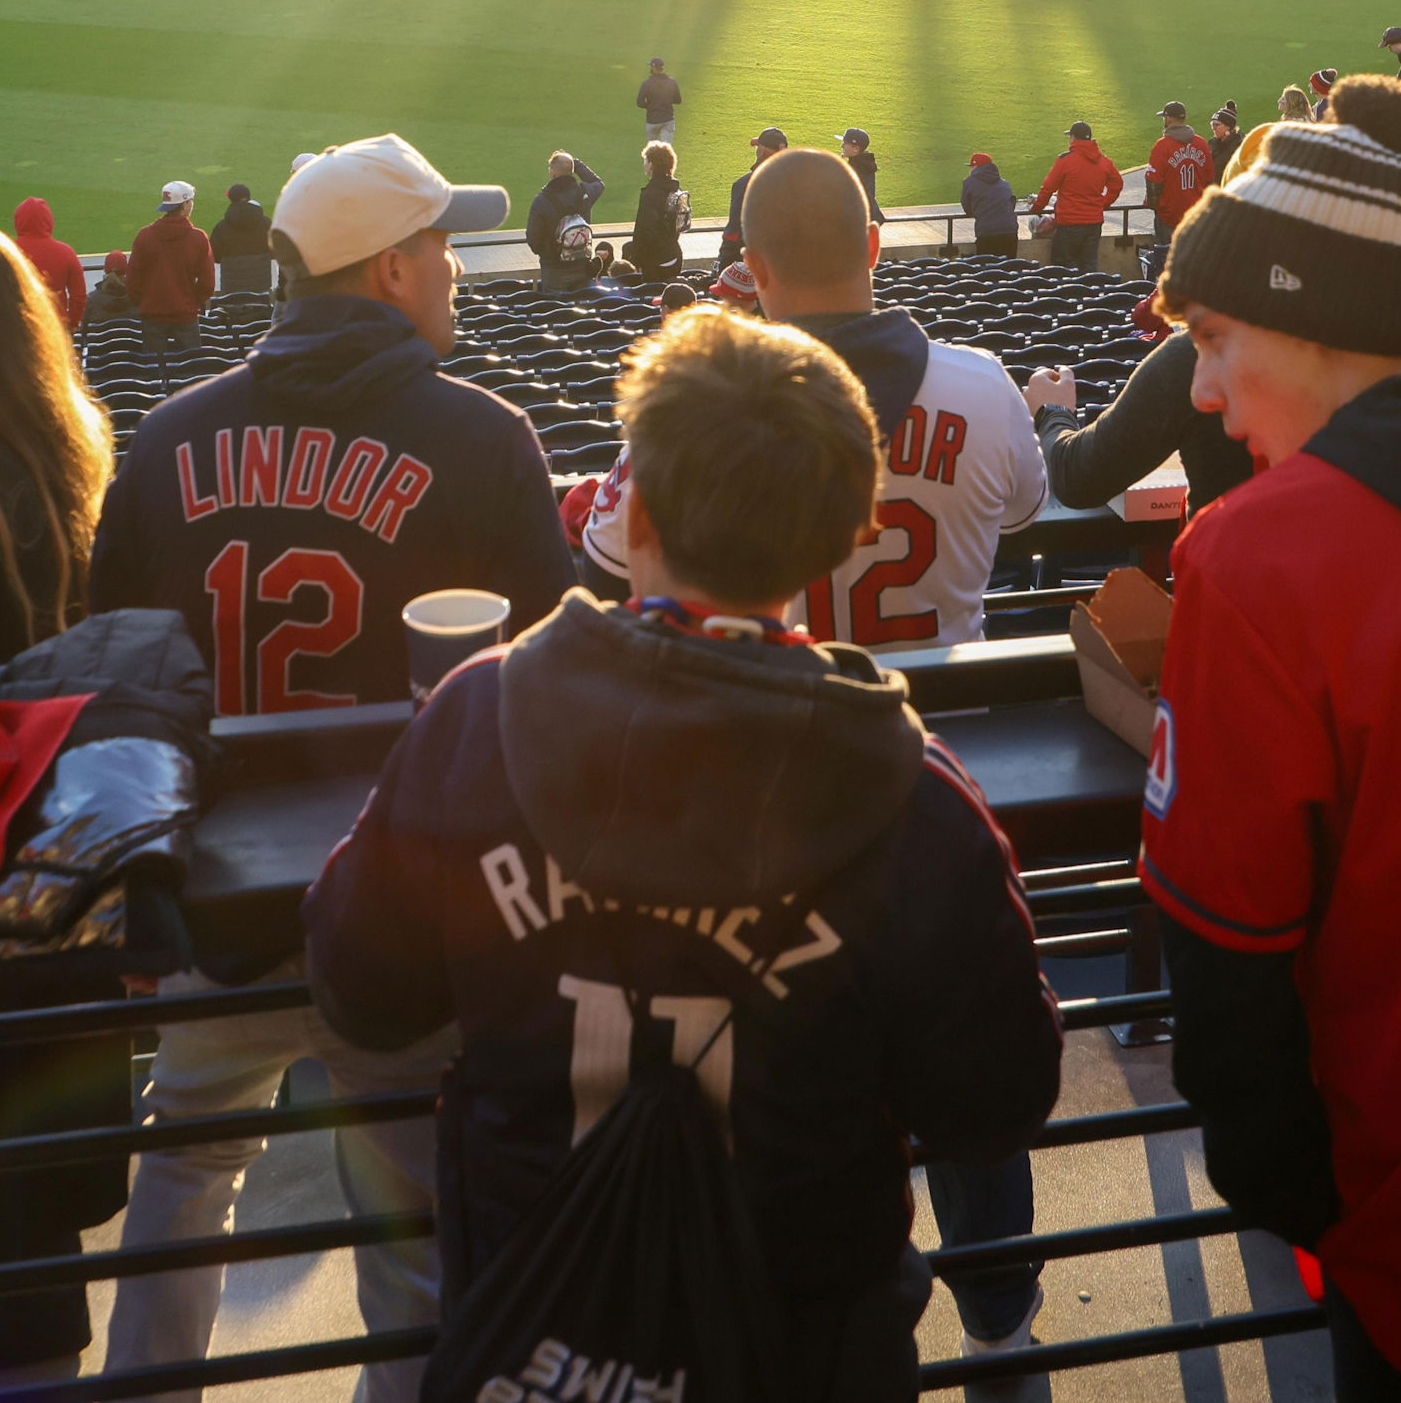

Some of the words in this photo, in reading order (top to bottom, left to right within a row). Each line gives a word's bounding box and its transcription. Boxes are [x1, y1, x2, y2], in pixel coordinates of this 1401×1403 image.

[1180, 164, 1195, 190] 11
[175, 425, 433, 544] LINDOR
[204, 539, 365, 717] 12
